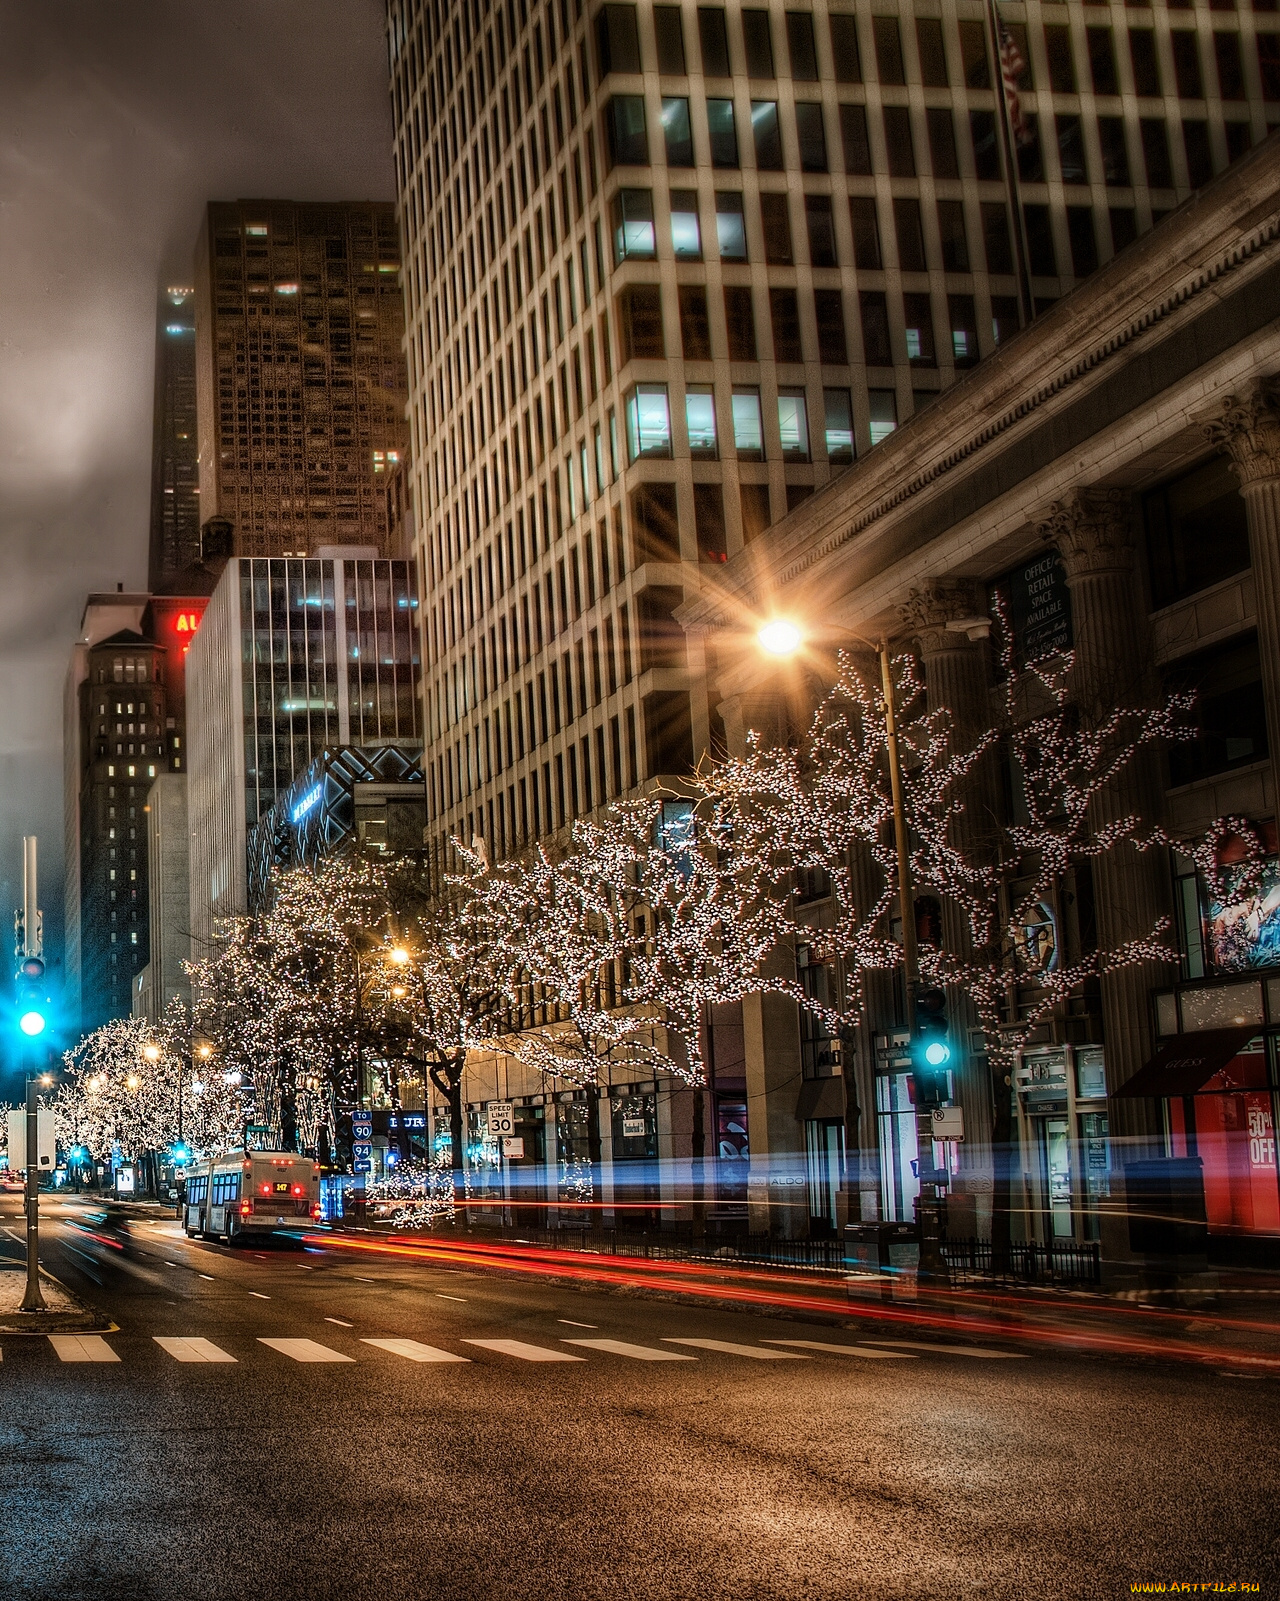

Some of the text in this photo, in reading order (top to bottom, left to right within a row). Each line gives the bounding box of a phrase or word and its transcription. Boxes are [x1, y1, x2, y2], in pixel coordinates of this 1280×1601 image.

[1028, 573, 1056, 597] RETAIL
[1031, 589, 1053, 609] SPACE
[1026, 600, 1062, 627] AVAILABLE
[1165, 1058, 1206, 1069] GUESS
[1037, 1104, 1054, 1112] CHASE
[491, 1119, 511, 1132] 30
[1248, 1112, 1273, 1138] 50%
[356, 1126, 370, 1137] 90
[355, 1147, 370, 1156] 94
[1250, 1138, 1275, 1164] OFF
[276, 1183, 288, 1191] 147
[771, 1177, 804, 1186] ALDO
